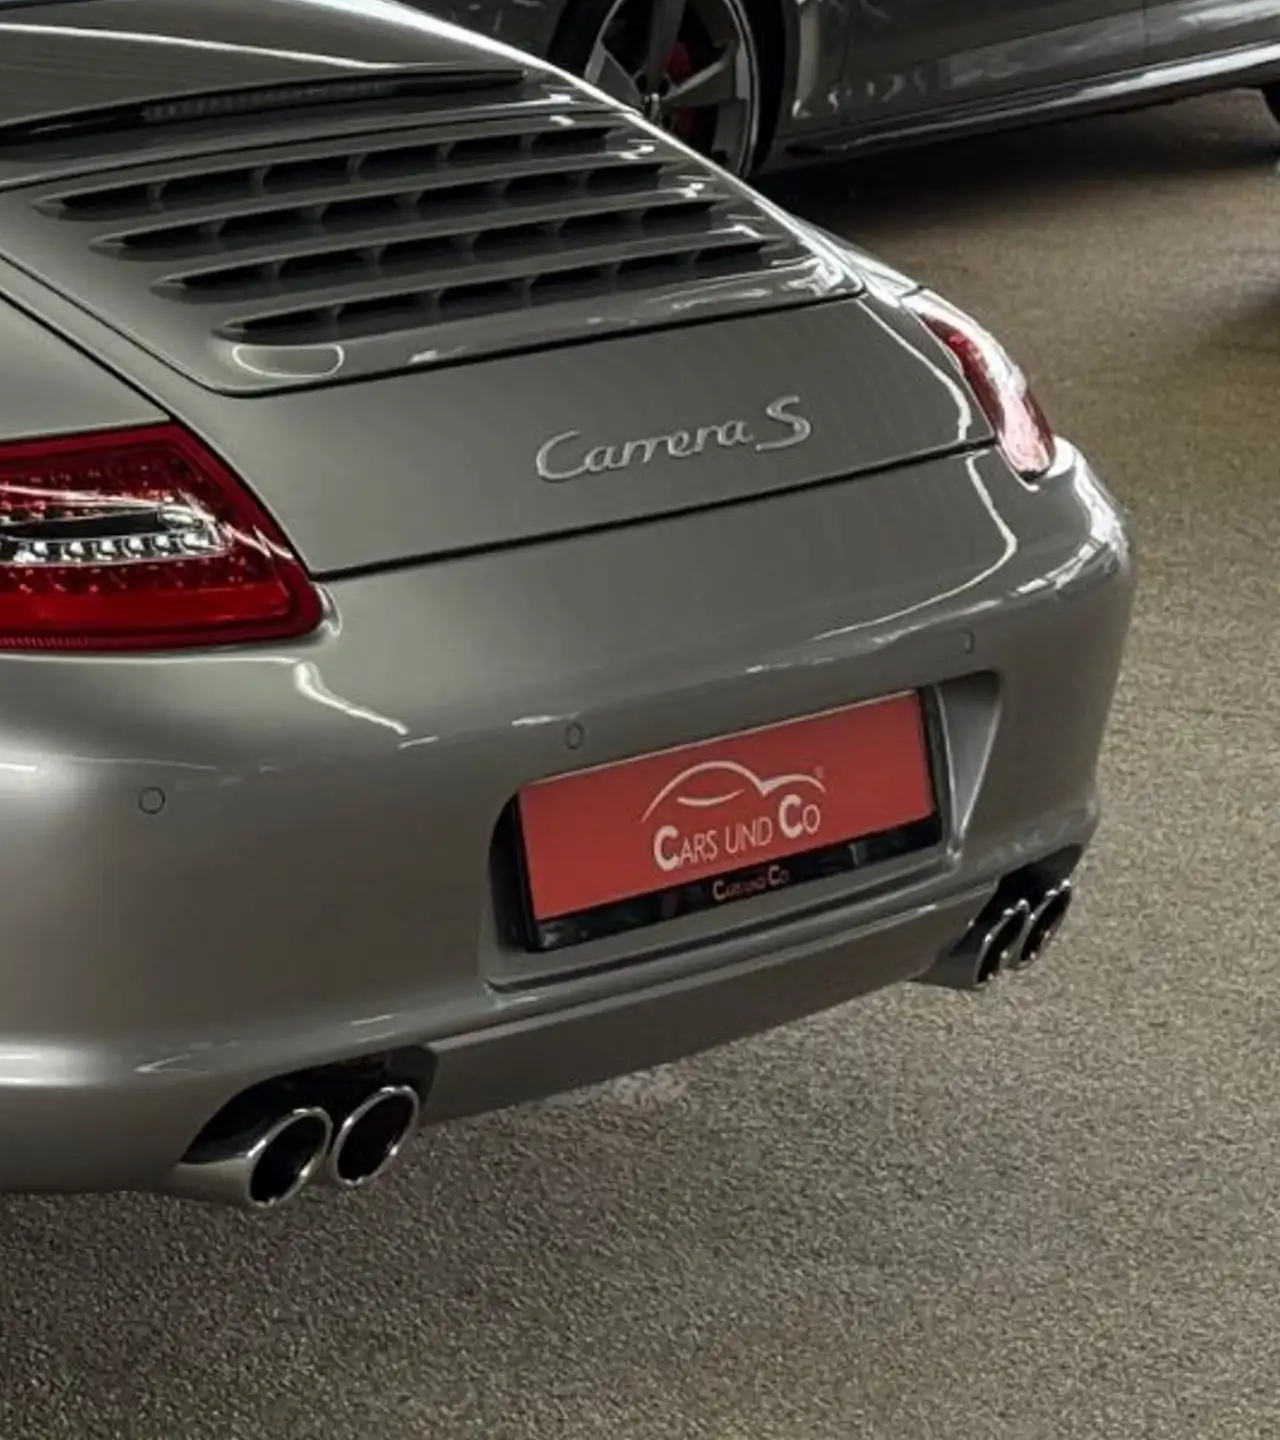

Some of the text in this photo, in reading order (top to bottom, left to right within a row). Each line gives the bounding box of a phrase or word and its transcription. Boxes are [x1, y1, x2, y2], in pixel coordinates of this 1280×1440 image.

[536, 394, 811, 480] Carrera S
[725, 816, 773, 854] UND
